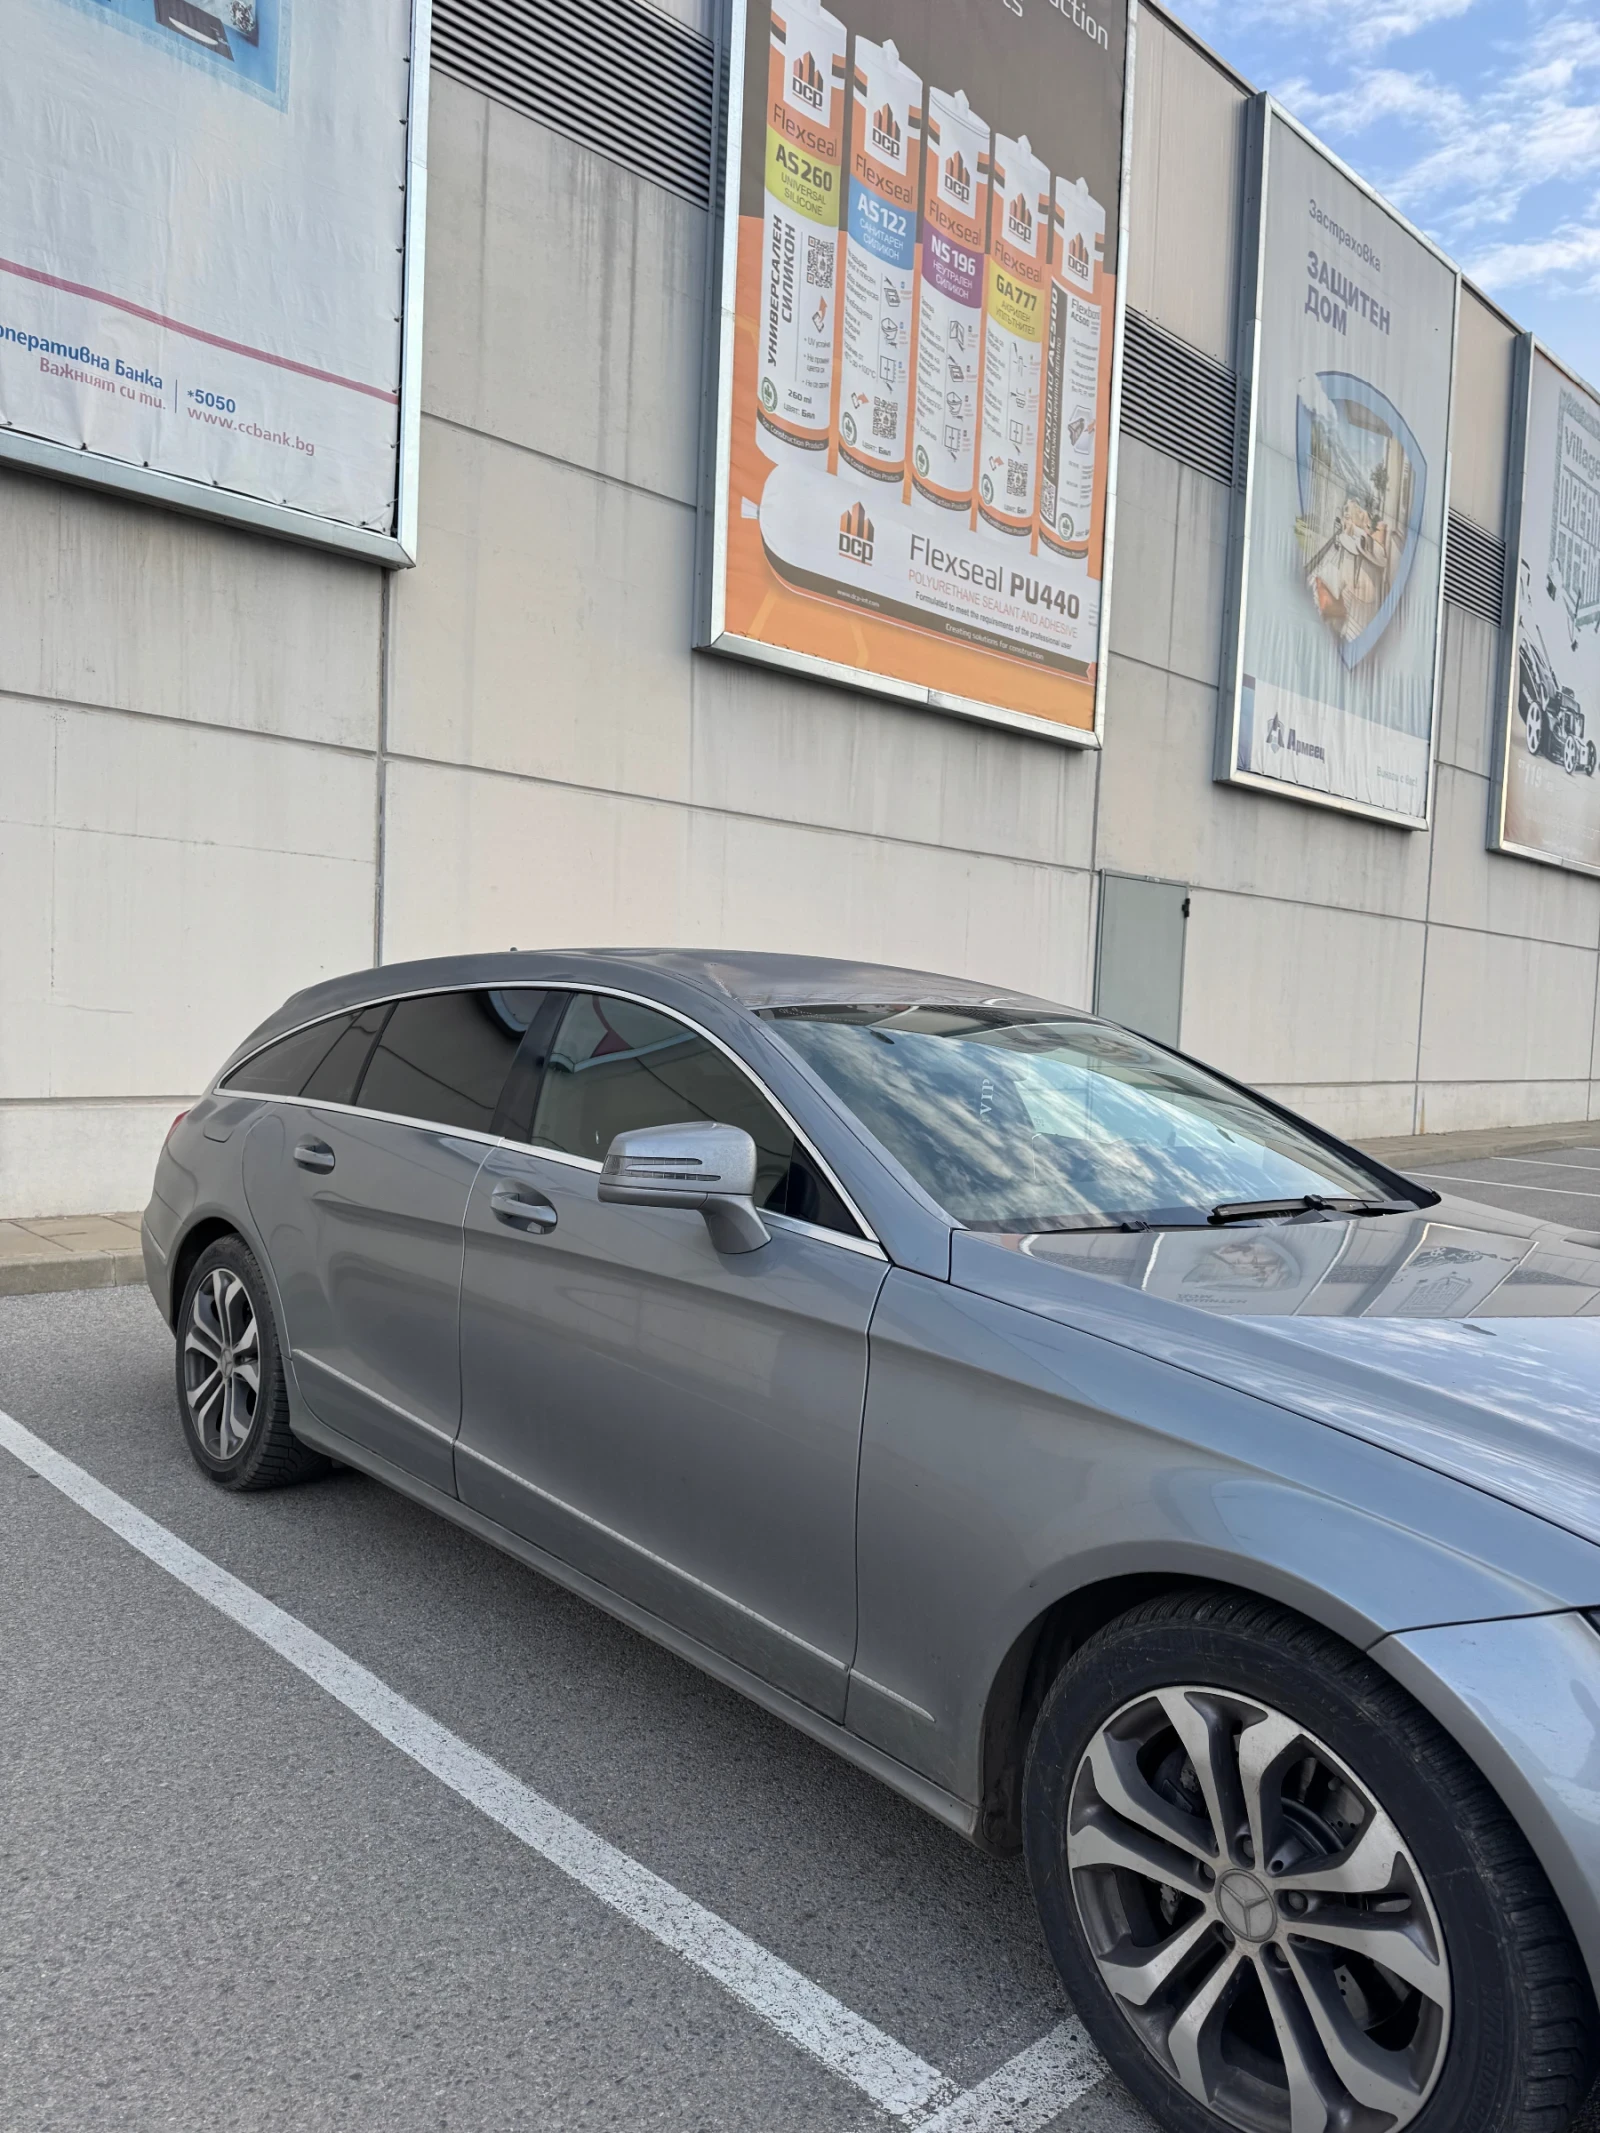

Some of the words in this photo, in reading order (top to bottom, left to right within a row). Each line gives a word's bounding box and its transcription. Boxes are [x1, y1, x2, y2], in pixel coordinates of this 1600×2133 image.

[773, 104, 837, 157] Flexseal
[781, 172, 826, 205] UNIVERSAL
[784, 188, 823, 216] SILICONE
[856, 154, 913, 204] Flexseal
[929, 199, 981, 246] Flexseal
[1309, 199, 1381, 272] Застраховка
[781, 223, 795, 323] СИЛИКОН
[995, 240, 1042, 283] Flexseal
[768, 215, 782, 366] УНИВЕРСАЛЕН
[1304, 284, 1347, 336] ДОМ
[1307, 250, 1390, 335] ЗАЩИТЕН
[40, 357, 115, 393] Важният
[119, 385, 135, 400] си
[139, 392, 166, 410] ти.
[115, 359, 163, 389] Банка
[788, 389, 802, 401] 260
[187, 407, 315, 457] www.ccbank.bg
[770, 425, 804, 447] Construction
[801, 409, 815, 419] Бял
[909, 533, 1003, 592] Flexseal
[1010, 572, 1080, 619] PU440
[908, 569, 980, 605] POLYURETHANE
[982, 594, 1020, 619] SEALANT
[1021, 607, 1038, 625] AND
[1038, 612, 1078, 639] ADHESIVE
[915, 591, 948, 609] Formulated
[949, 602, 955, 612] to
[956, 605, 969, 616] meet
[970, 609, 979, 621] the
[980, 614, 1014, 632] requirements
[1015, 624, 1021, 633] of
[1021, 626, 1029, 636] the
[1030, 628, 1060, 647] professional
[1061, 639, 1072, 650] user
[946, 623, 971, 640] Creating
[972, 631, 999, 647] solutions
[999, 640, 1008, 649] for
[1009, 643, 1044, 660] construction
[1287, 728, 1325, 764] Армеец
